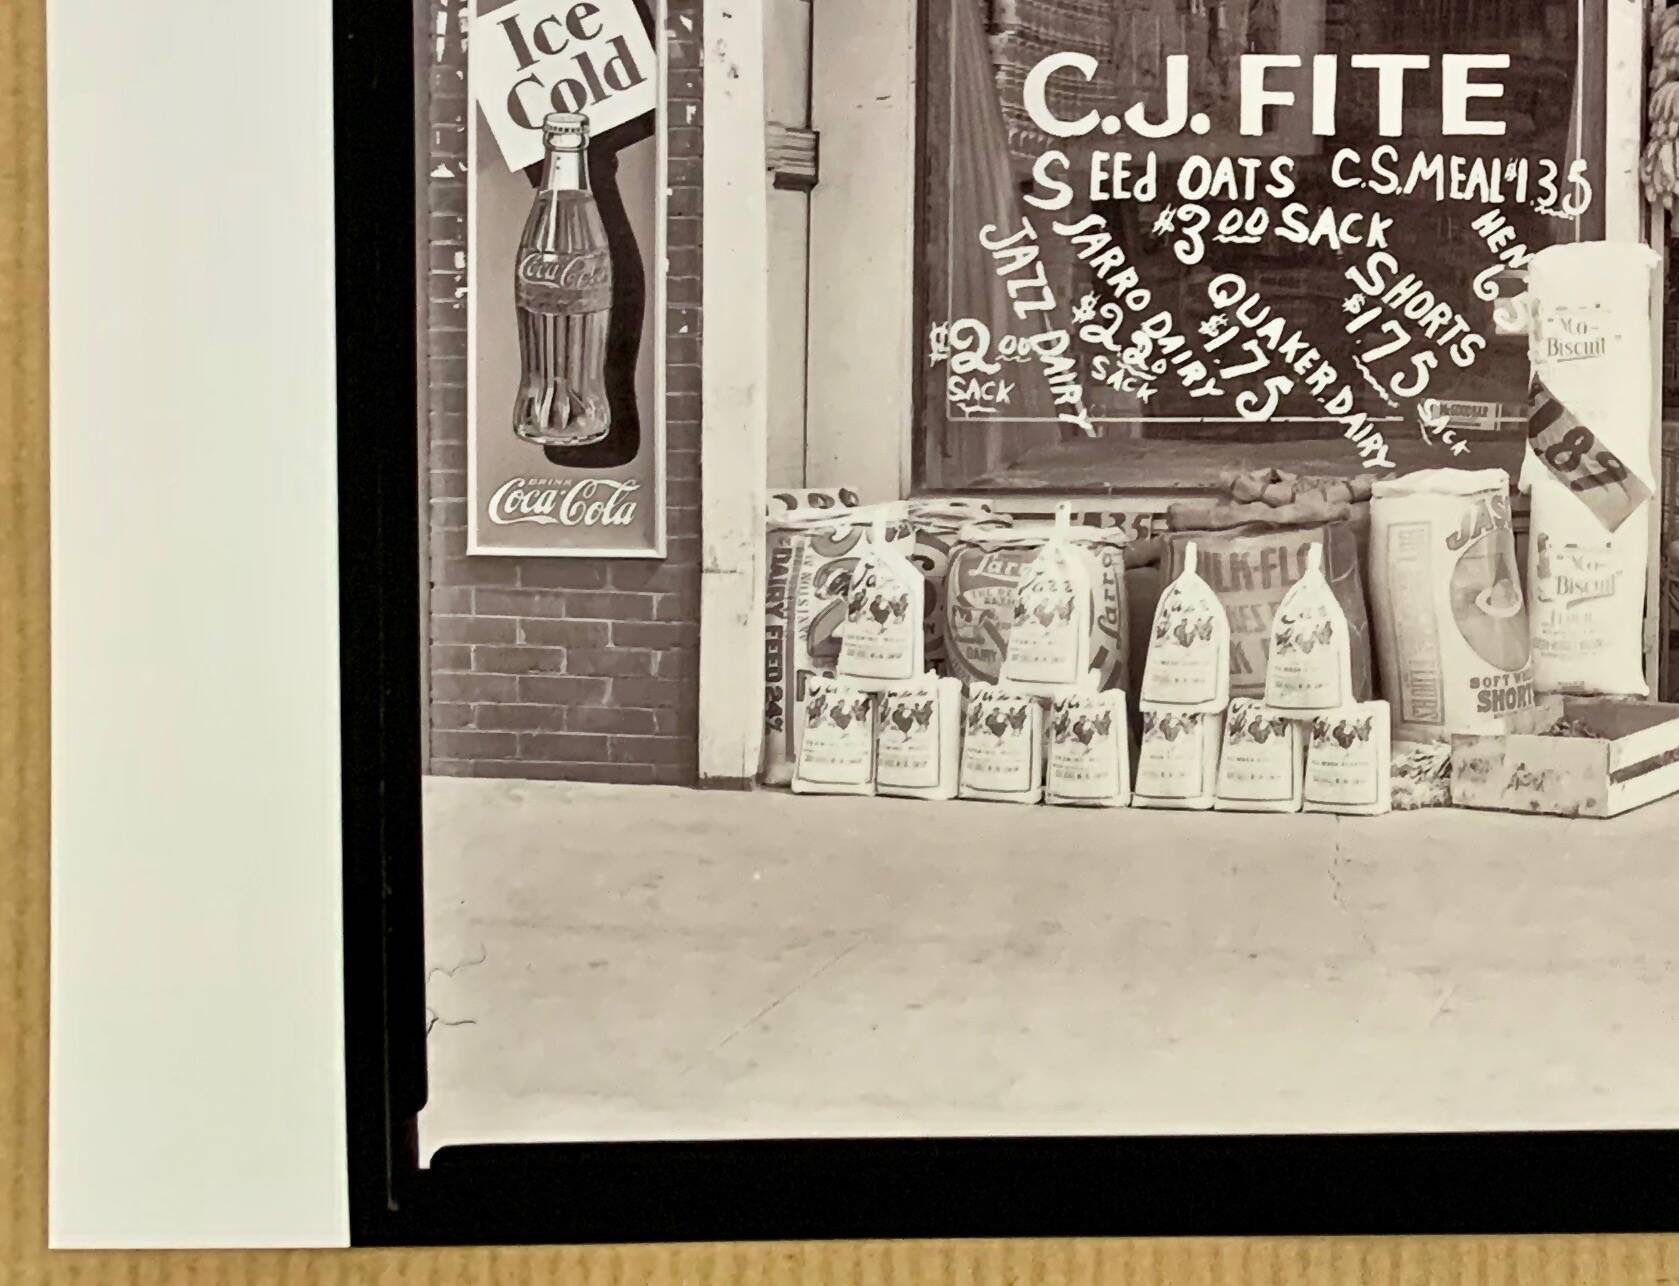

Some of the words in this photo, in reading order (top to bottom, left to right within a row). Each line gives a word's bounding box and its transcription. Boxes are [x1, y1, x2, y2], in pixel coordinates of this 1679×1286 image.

[497, 2, 603, 72] Ice
[507, 35, 647, 130] Cold
[1240, 54, 1511, 137] FITE
[1177, 155, 1295, 201] OATS
[1274, 203, 1394, 250] SACK
[979, 216, 1057, 320] JAZZ
[1030, 329, 1097, 438] DAIRY
[1344, 251, 1487, 368] SHORTS
[1090, 355, 1158, 405] SACK
[1141, 311, 1225, 398] DAIRY
[947, 375, 1015, 405] SACK
[1324, 385, 1396, 469] DAIRY
[1417, 398, 1472, 457] SACK
[527, 478, 573, 487] DRINK
[765, 547, 792, 619] DAIRY
[765, 625, 784, 682] FEED
[1469, 674, 1510, 690] SOFT
